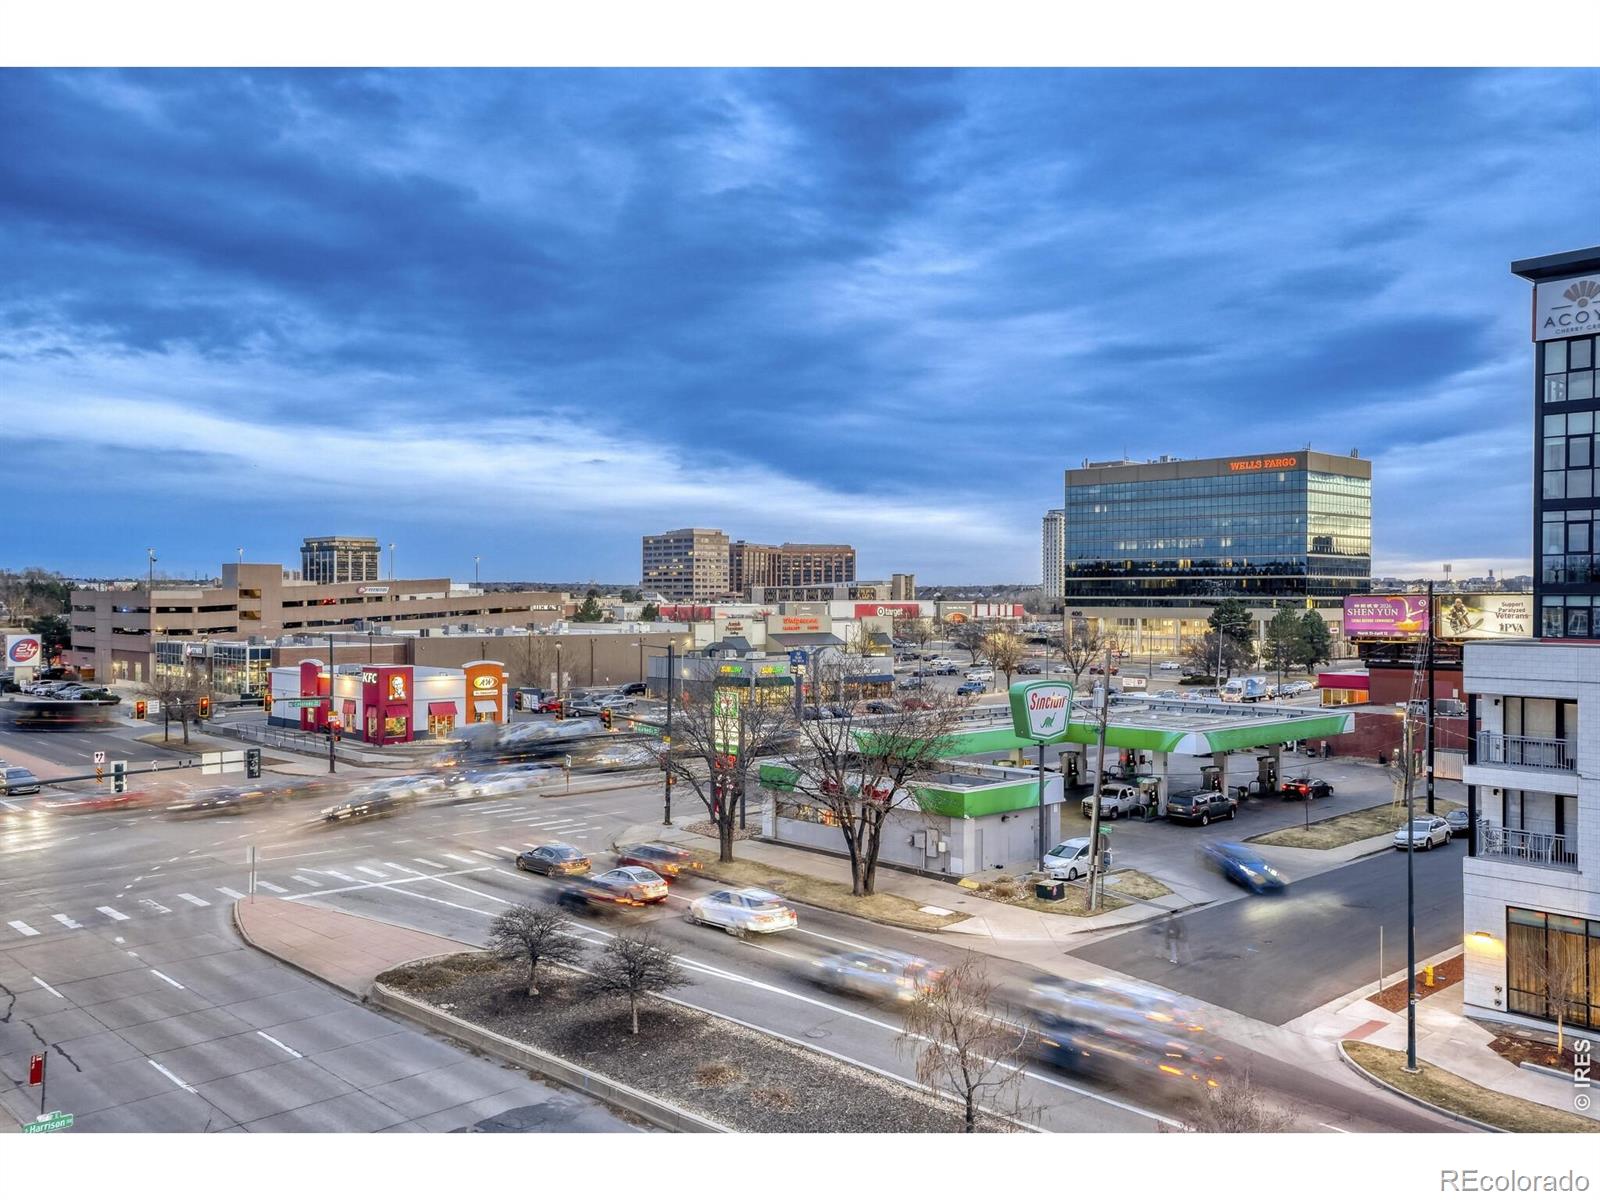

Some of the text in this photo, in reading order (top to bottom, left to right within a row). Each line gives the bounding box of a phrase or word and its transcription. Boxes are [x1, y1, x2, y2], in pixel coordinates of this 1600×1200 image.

[1230, 457, 1297, 471] WELLS FARGO
[885, 607, 904, 617] target
[1347, 608, 1399, 616] SHEN YUN
[1495, 612, 1529, 620] Veterans
[1504, 623, 1525, 632] PVA
[16, 643, 38, 658] 24
[362, 672, 378, 684] KFC
[30, 1119, 65, 1133] Harrison
